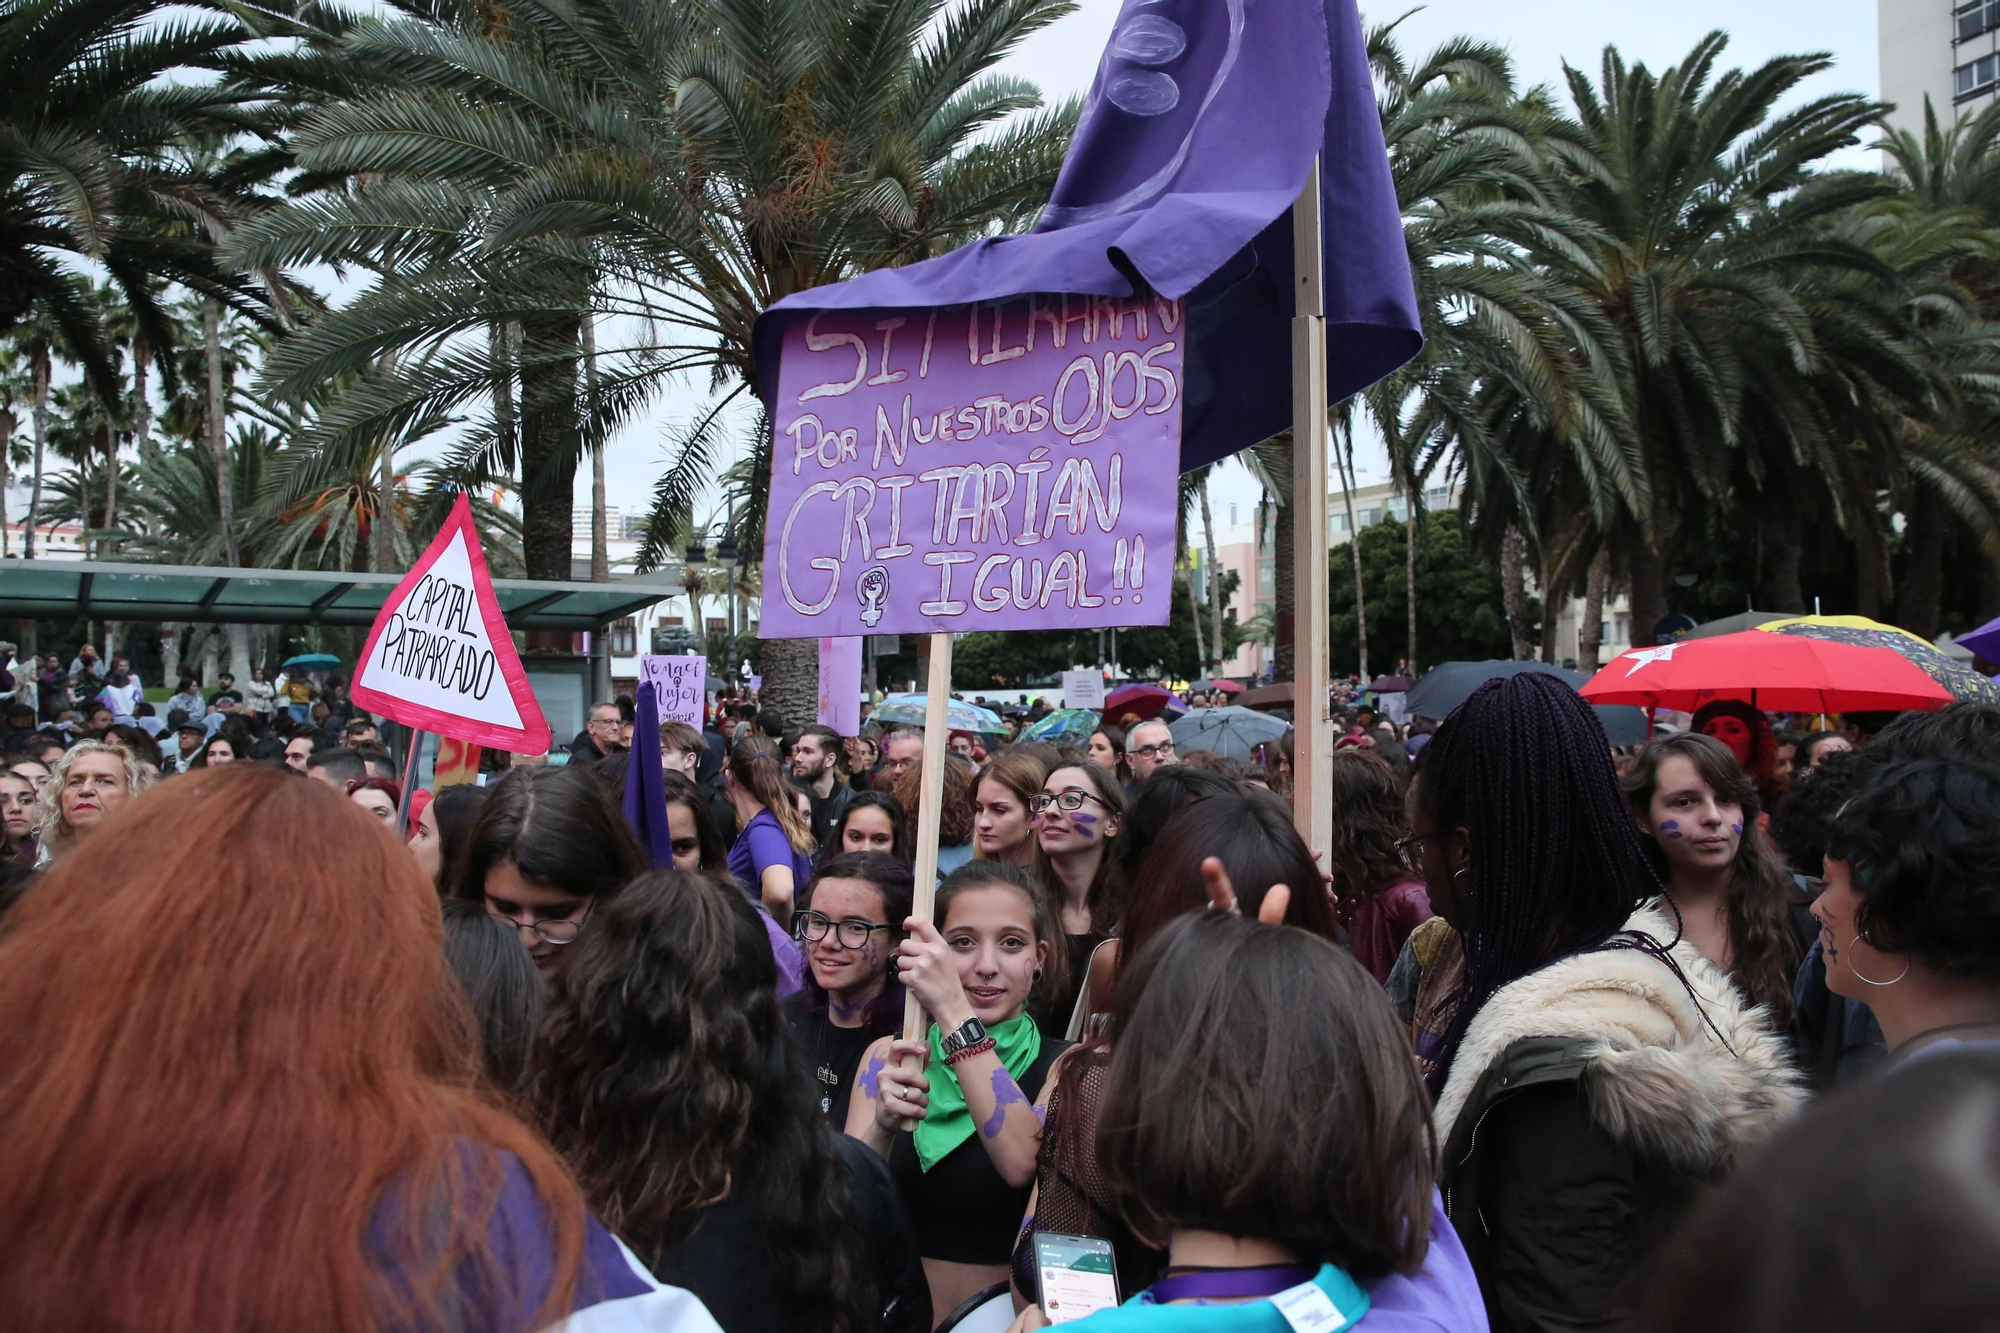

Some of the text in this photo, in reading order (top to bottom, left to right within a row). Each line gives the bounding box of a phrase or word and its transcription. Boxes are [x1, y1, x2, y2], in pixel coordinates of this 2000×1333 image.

[1052, 341, 1178, 446] OJOS
[778, 445, 1123, 616] GRITARÍAN
[405, 573, 478, 639] CAPITAL
[380, 612, 496, 701] PATRIARCADO
